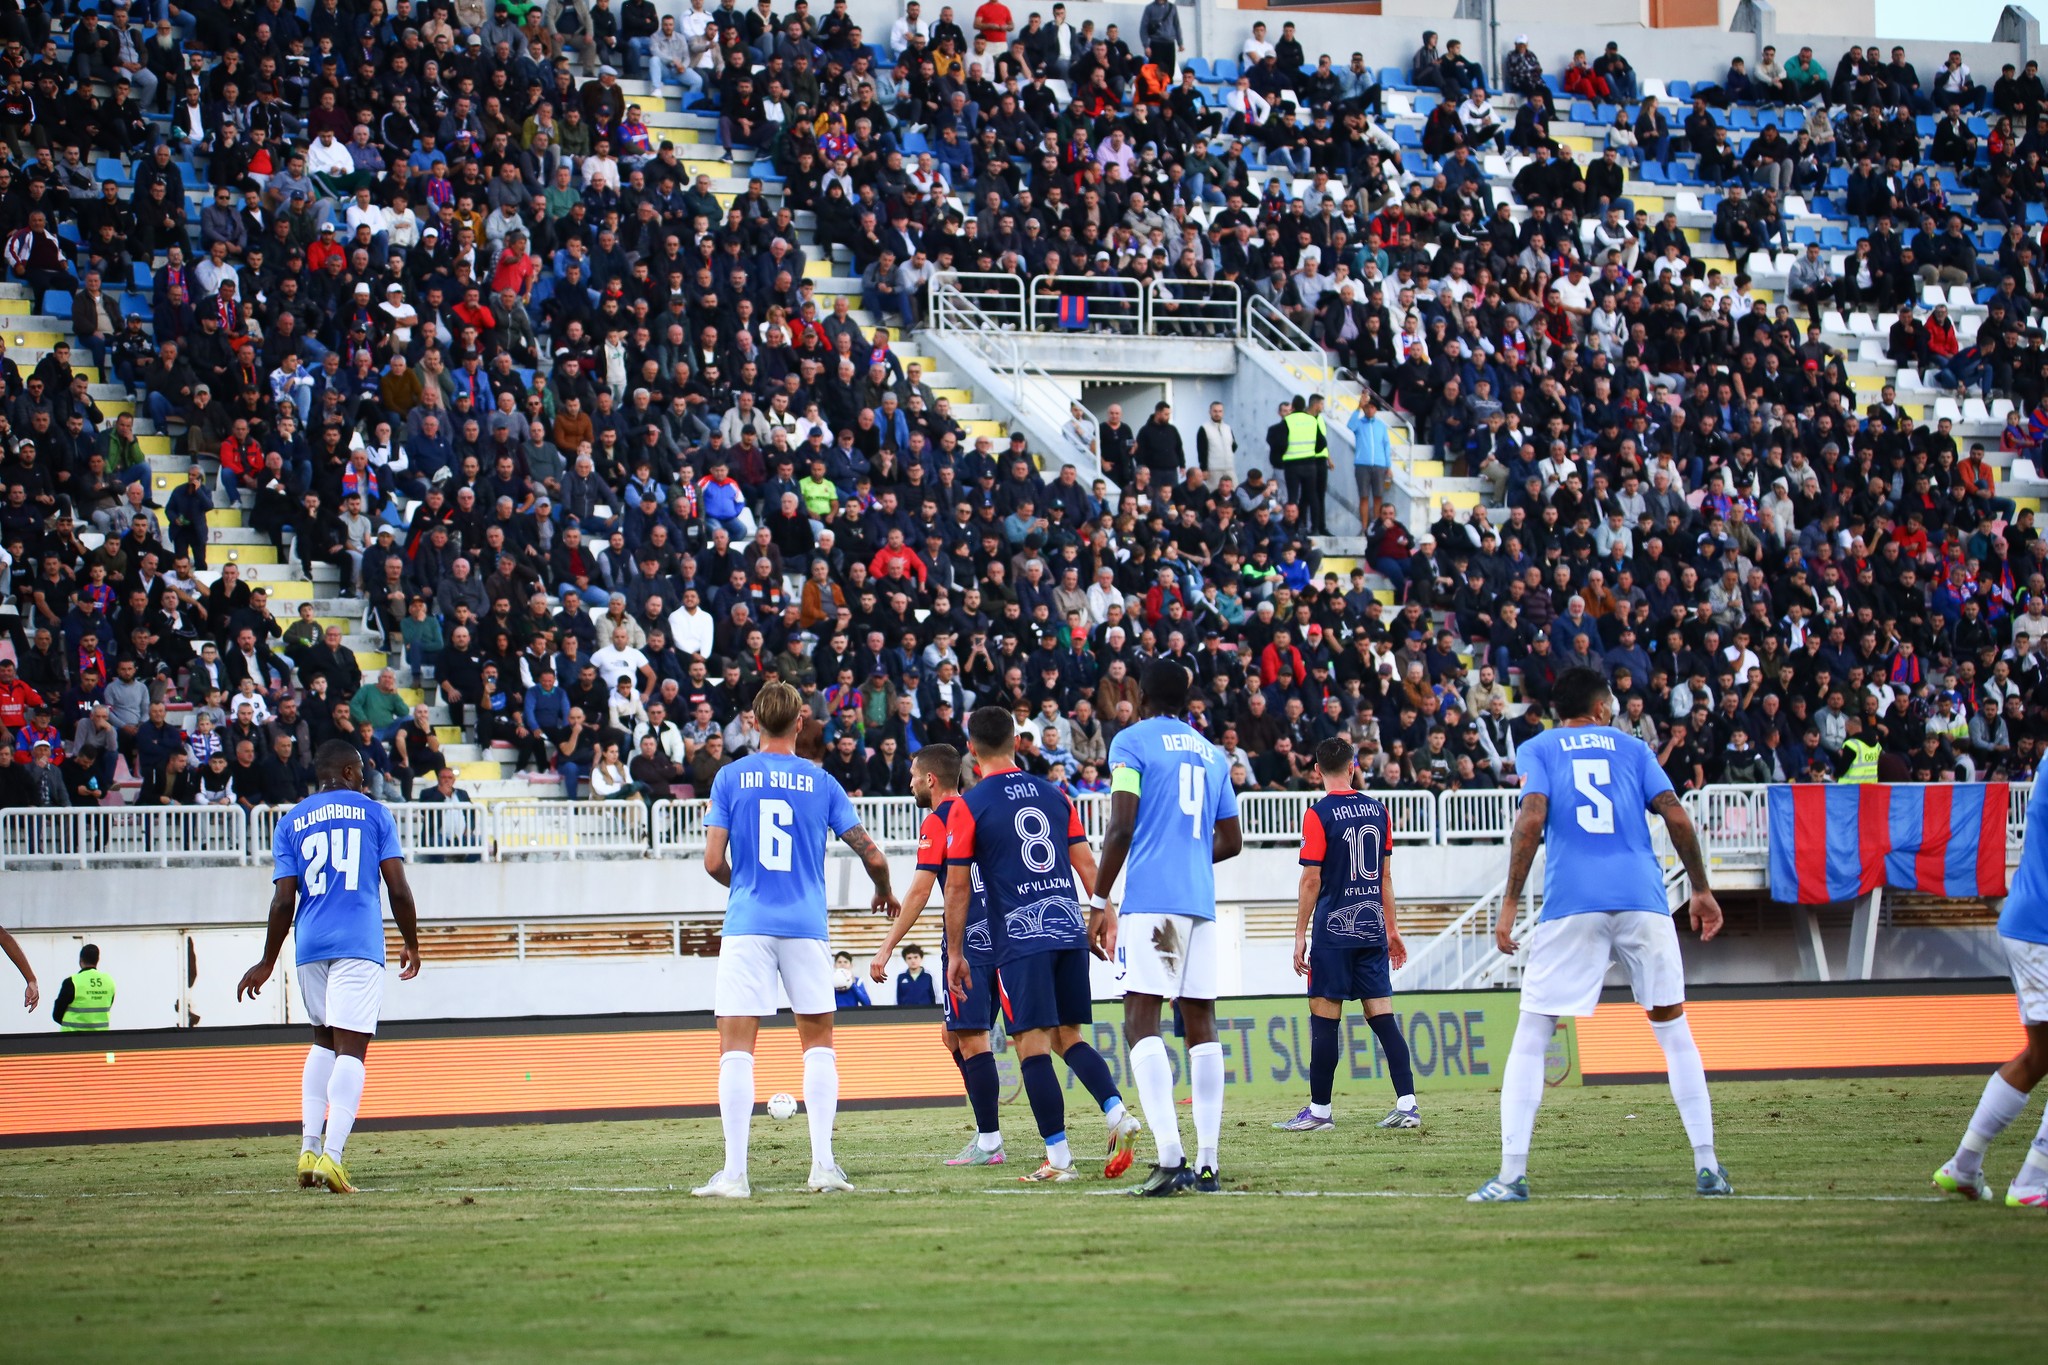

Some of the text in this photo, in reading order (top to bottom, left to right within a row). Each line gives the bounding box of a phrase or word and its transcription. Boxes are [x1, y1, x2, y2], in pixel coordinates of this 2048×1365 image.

[1559, 733, 1616, 752] LLESHI
[740, 770, 814, 793] IAN SOLER
[1004, 782, 1040, 801] SALA
[1178, 761, 1206, 840] 4
[1571, 758, 1615, 834] 5
[1332, 803, 1381, 821] KALLAKU
[758, 798, 794, 872] 6
[1014, 806, 1056, 873] 8
[301, 827, 361, 897] 24
[1342, 824, 1381, 881] 10
[1016, 882, 1031, 895] KF
[1117, 946, 1127, 969] 4
[90, 977, 103, 988] 55
